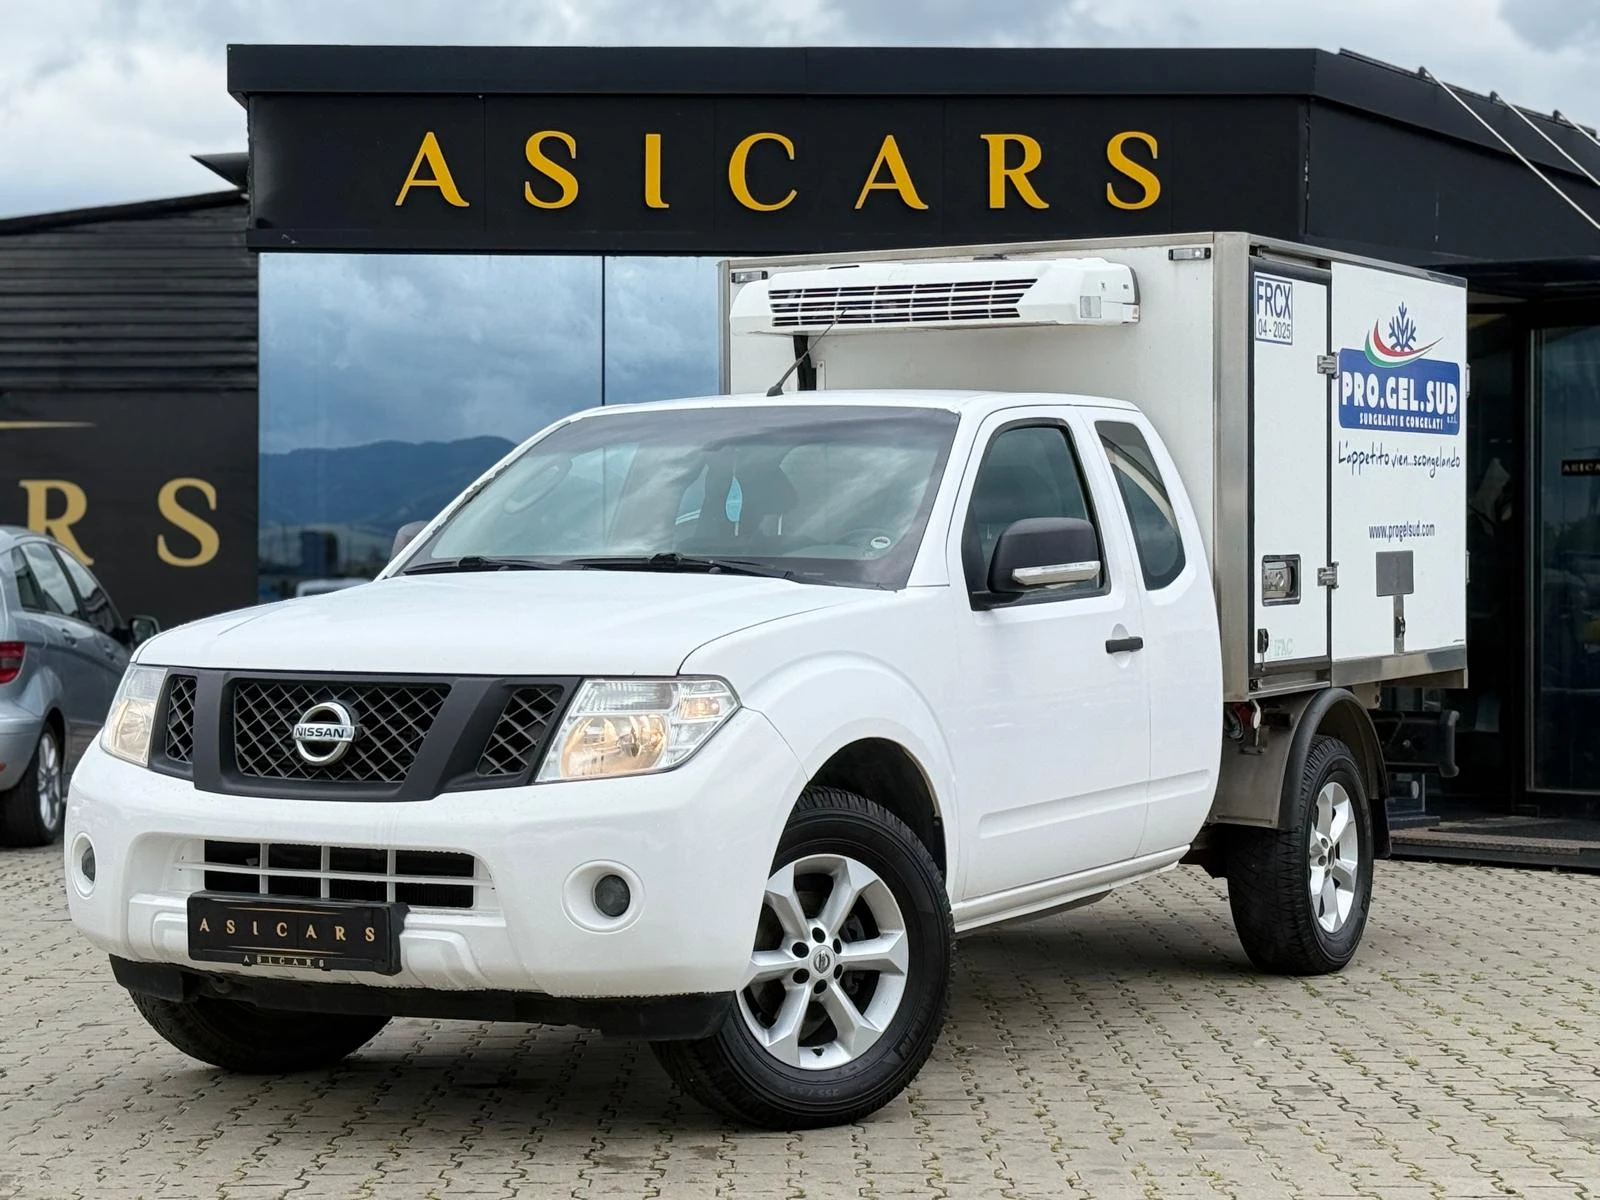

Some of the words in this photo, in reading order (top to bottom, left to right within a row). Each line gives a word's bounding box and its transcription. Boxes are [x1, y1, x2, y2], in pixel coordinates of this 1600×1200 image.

[395, 130, 1162, 212] ASICARS
[1257, 280, 1291, 320] FRCX
[1273, 321, 1291, 339] 2025
[1341, 371, 1458, 415] PRO.GEL.SUD
[1360, 412, 1398, 427] SURGELATI
[1406, 416, 1443, 430] CONGELATI
[1338, 440, 1390, 476] L'appetito
[1368, 520, 1436, 543] www.progelsud.com
[294, 727, 345, 738] NISSAN
[199, 917, 376, 943] ASICARS
[243, 954, 325, 967] ASICARS
